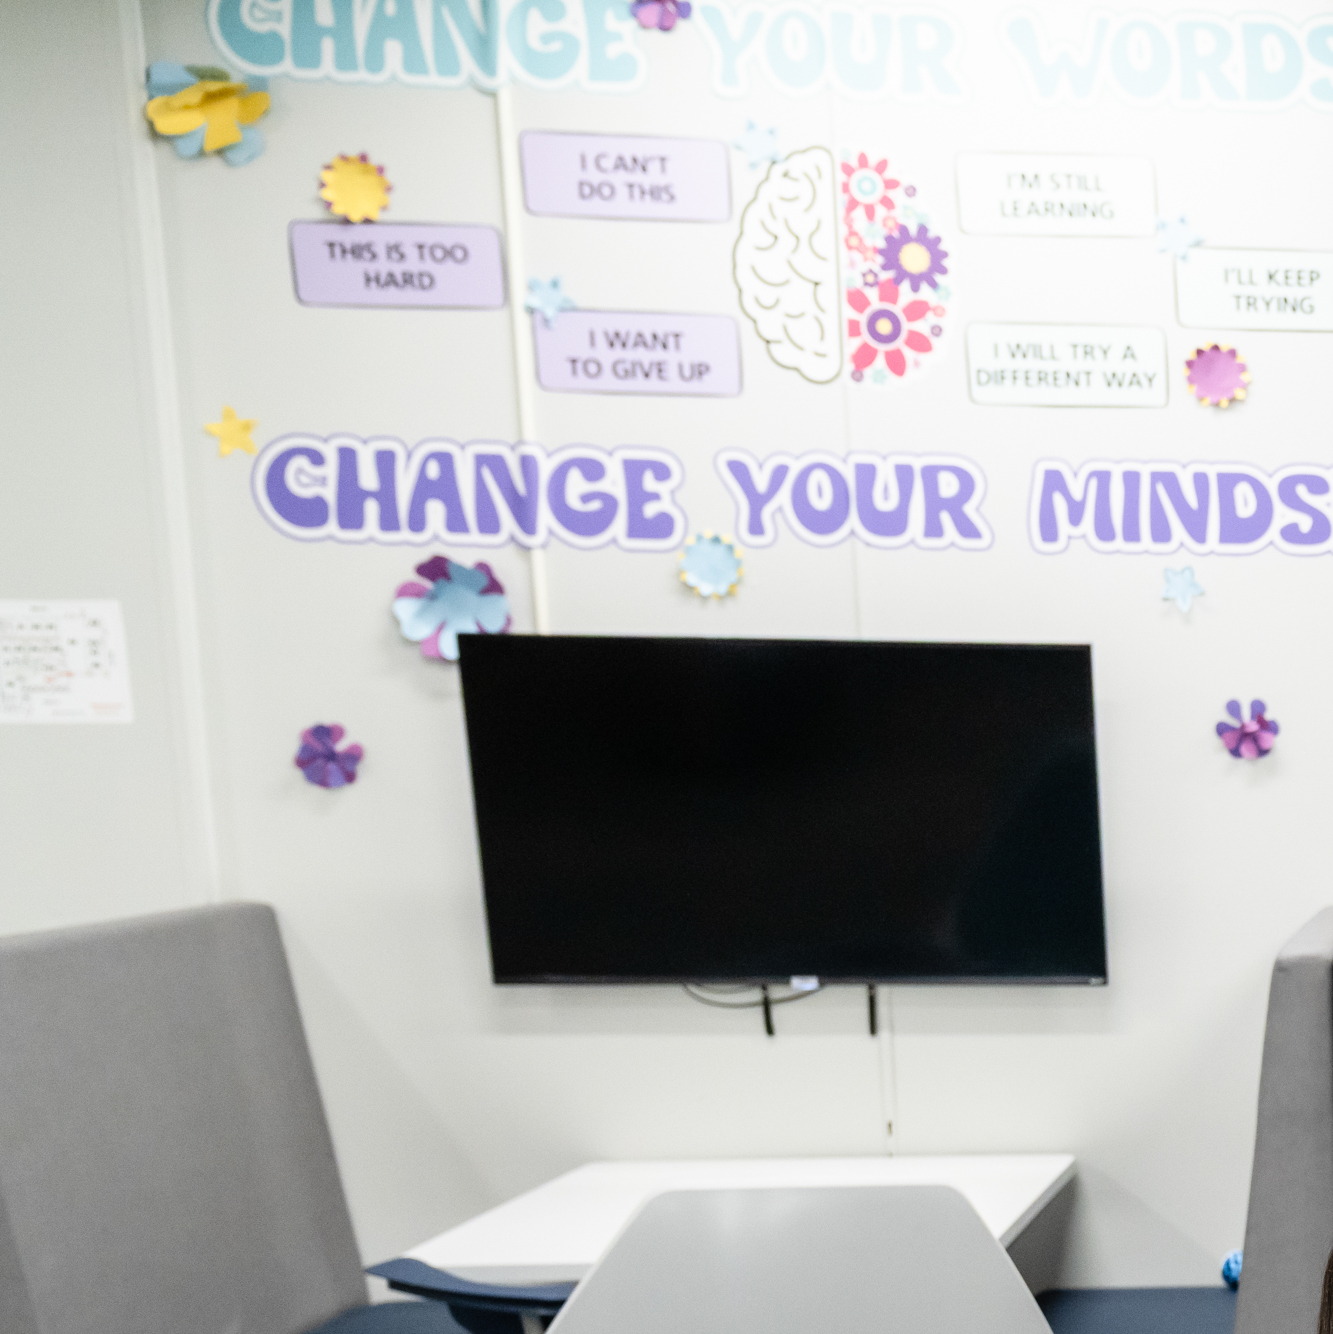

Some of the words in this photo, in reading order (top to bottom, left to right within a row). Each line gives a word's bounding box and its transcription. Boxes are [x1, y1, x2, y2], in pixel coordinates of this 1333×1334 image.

[216, 0, 641, 85] CHANGE
[697, 2, 962, 97] YOUR
[579, 152, 588, 175] I
[593, 152, 671, 178] CAN'T
[577, 179, 616, 203] DO
[621, 181, 677, 205] THIS
[1005, 171, 1042, 193] I'M
[1048, 172, 1106, 195] STILL
[999, 198, 1116, 222] LEARNING
[324, 241, 378, 264] THIS
[385, 242, 408, 264] IS
[414, 242, 470, 265] TOO
[362, 267, 437, 293] HARD
[1222, 266, 1261, 288] I'LL
[1265, 267, 1322, 289] KEEP
[1231, 292, 1317, 317] TRYING
[588, 328, 597, 351] I
[603, 329, 686, 354] WANT
[992, 341, 1000, 363] I
[1010, 342, 1062, 364] WILL
[1069, 343, 1112, 365] TRY
[1117, 343, 1140, 364] A
[567, 356, 603, 380] TO
[609, 358, 670, 382] GIVE
[677, 359, 713, 384] UP
[975, 367, 1095, 391] DIFFERENT
[1101, 369, 1159, 392] WAY
[263, 445, 678, 542] CHANGE
[725, 457, 985, 541] YOUR
